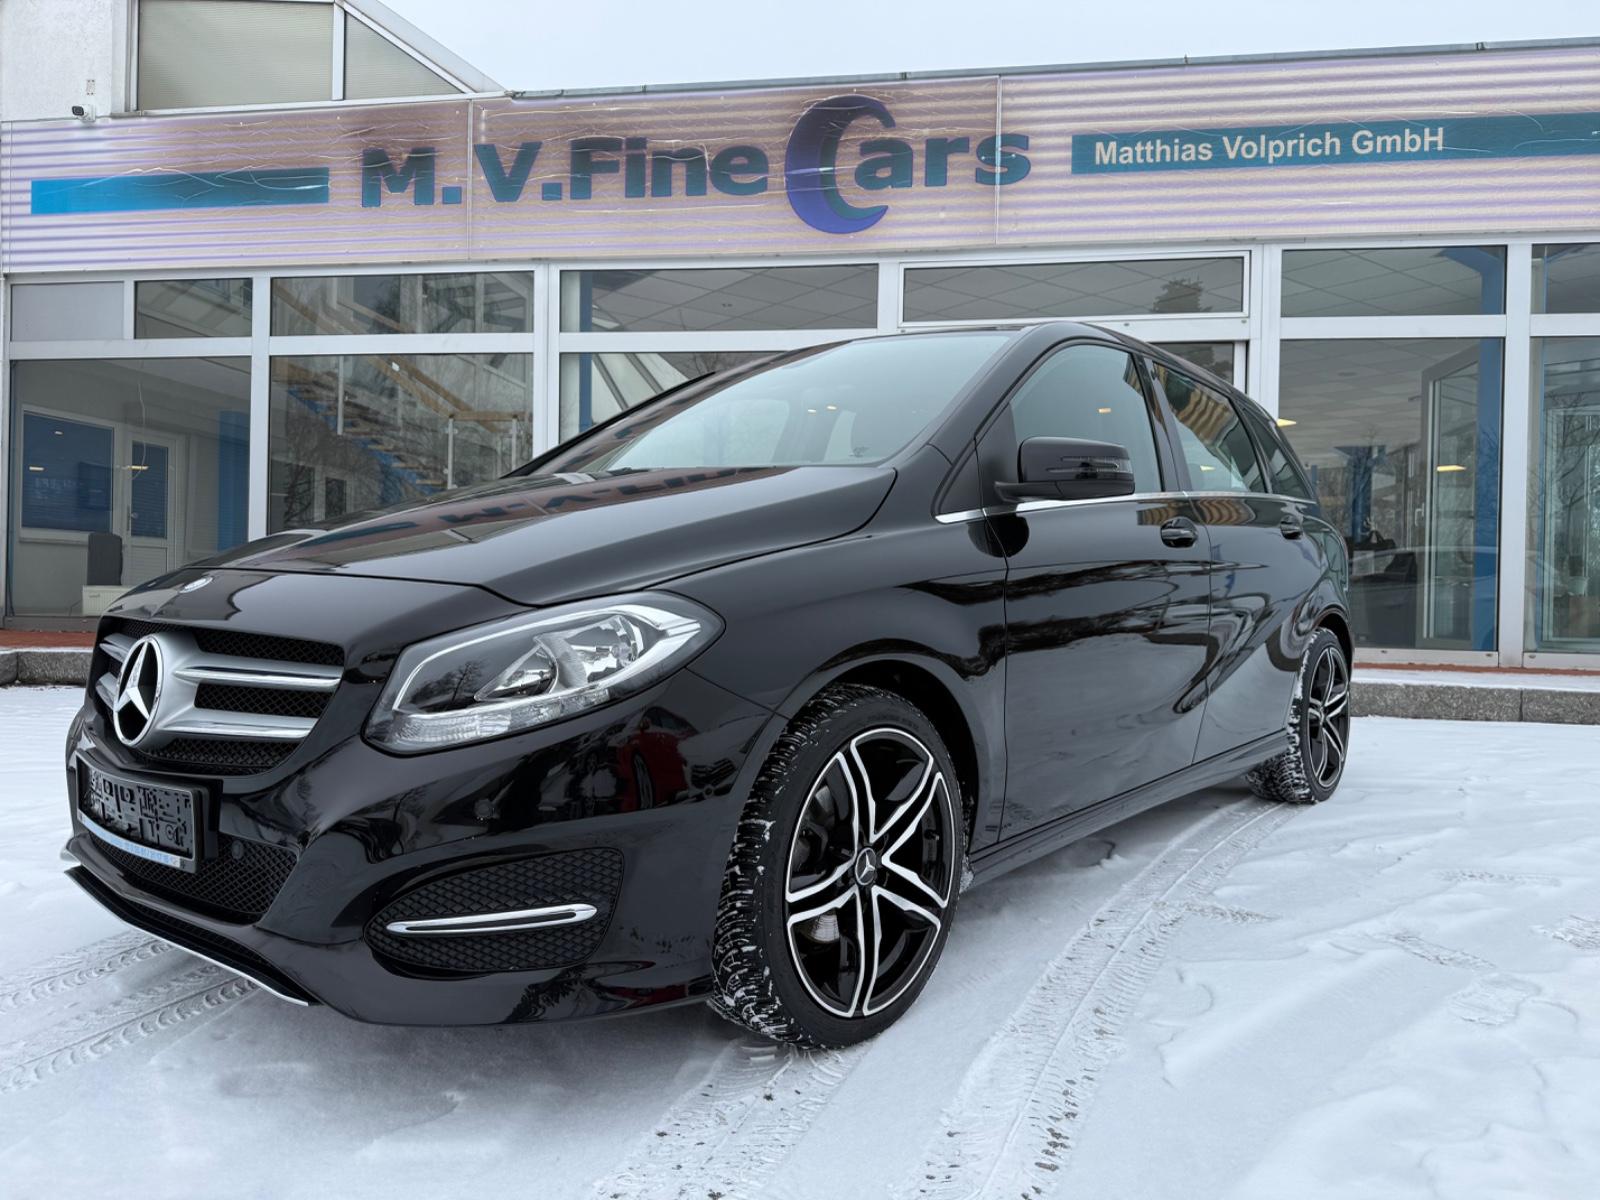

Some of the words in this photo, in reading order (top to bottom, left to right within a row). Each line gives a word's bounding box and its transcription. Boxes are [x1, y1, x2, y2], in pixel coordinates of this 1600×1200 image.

[1094, 138, 1214, 166] Matthias
[1221, 131, 1342, 164] Volprich
[1350, 127, 1445, 154] GmbH
